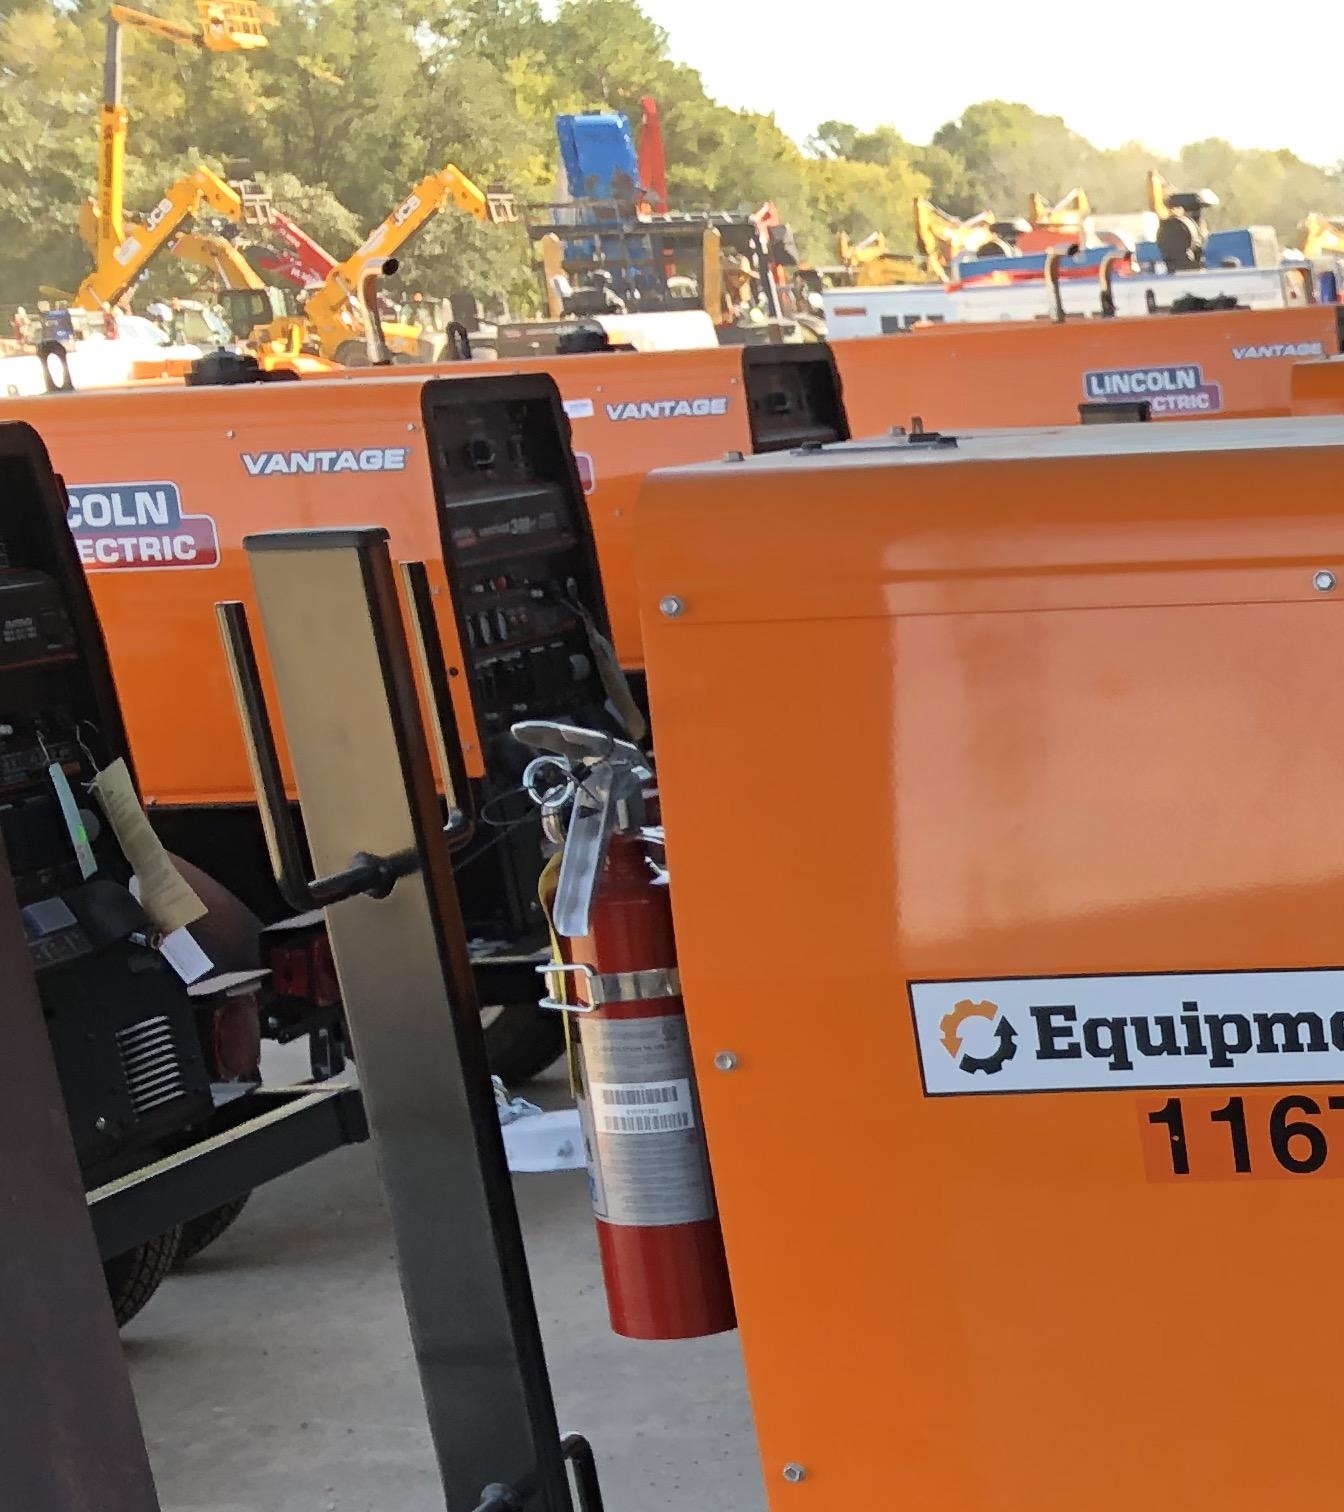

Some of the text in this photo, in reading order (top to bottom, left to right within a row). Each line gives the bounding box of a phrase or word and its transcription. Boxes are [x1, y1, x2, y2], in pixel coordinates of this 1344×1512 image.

[1090, 369, 1196, 395] LINCOLN
[607, 398, 727, 421] VANTAGE
[241, 448, 406, 475] VANTAGE
[67, 491, 169, 528] COLN
[76, 534, 197, 564] ECTRIC
